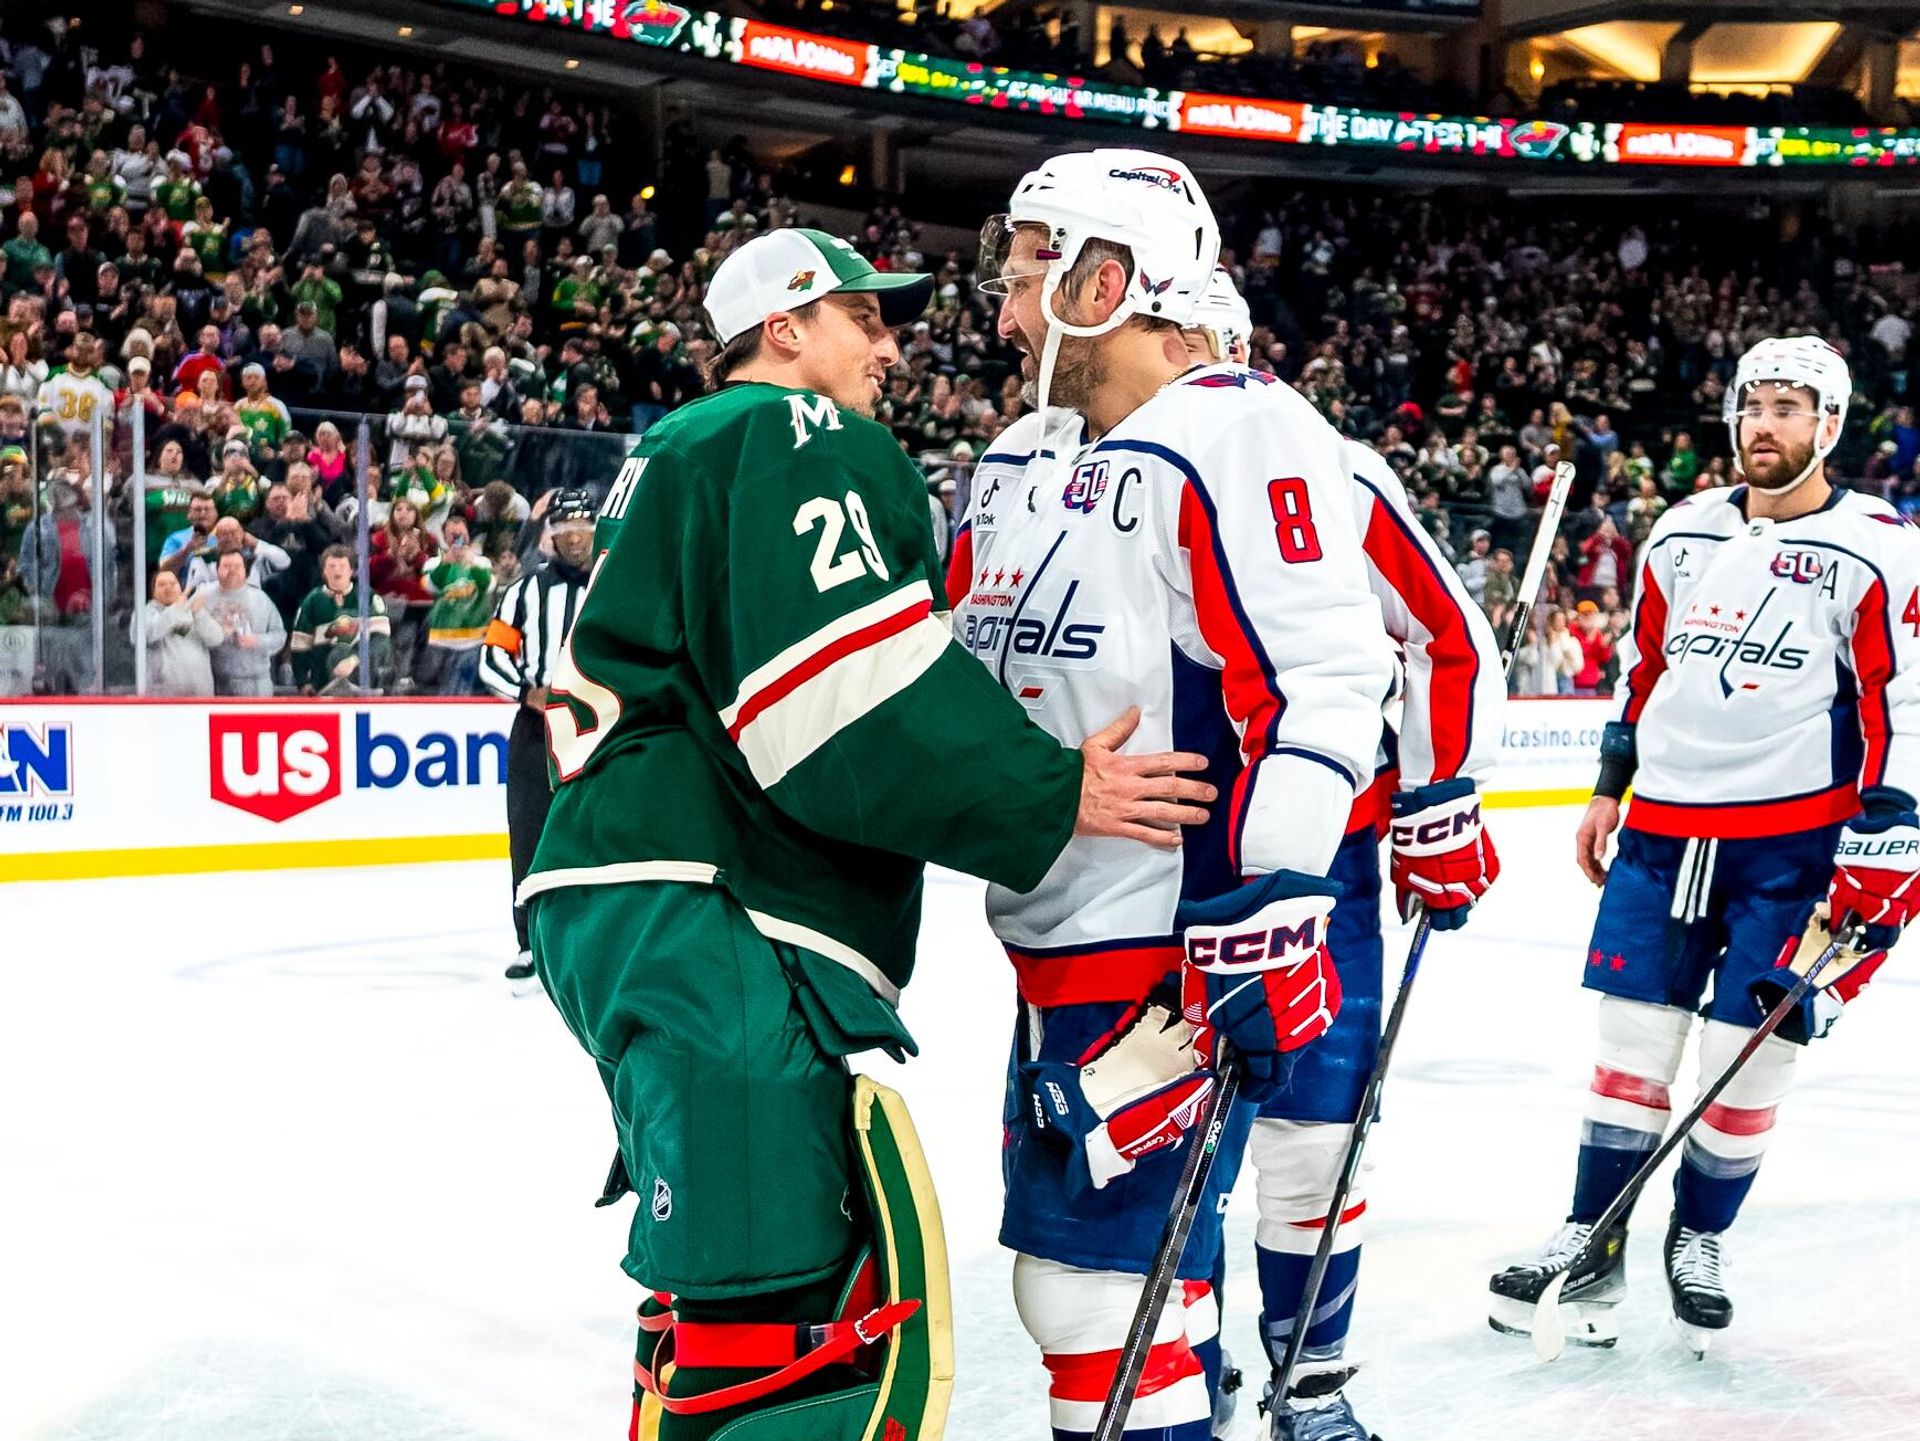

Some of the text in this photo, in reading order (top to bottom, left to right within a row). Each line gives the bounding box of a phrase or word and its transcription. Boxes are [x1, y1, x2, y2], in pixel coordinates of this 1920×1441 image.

[1351, 116, 1393, 140] DAY
[783, 394, 844, 449] M
[1112, 467, 1142, 533] C
[1267, 477, 1323, 564] 8
[792, 490, 890, 594] 29
[1775, 551, 1823, 580] 50
[1818, 560, 1840, 600] A
[221, 731, 331, 796] us
[1389, 802, 1481, 847] CCM
[1187, 915, 1317, 968] CCM
[1032, 1093, 1045, 1129] CCM
